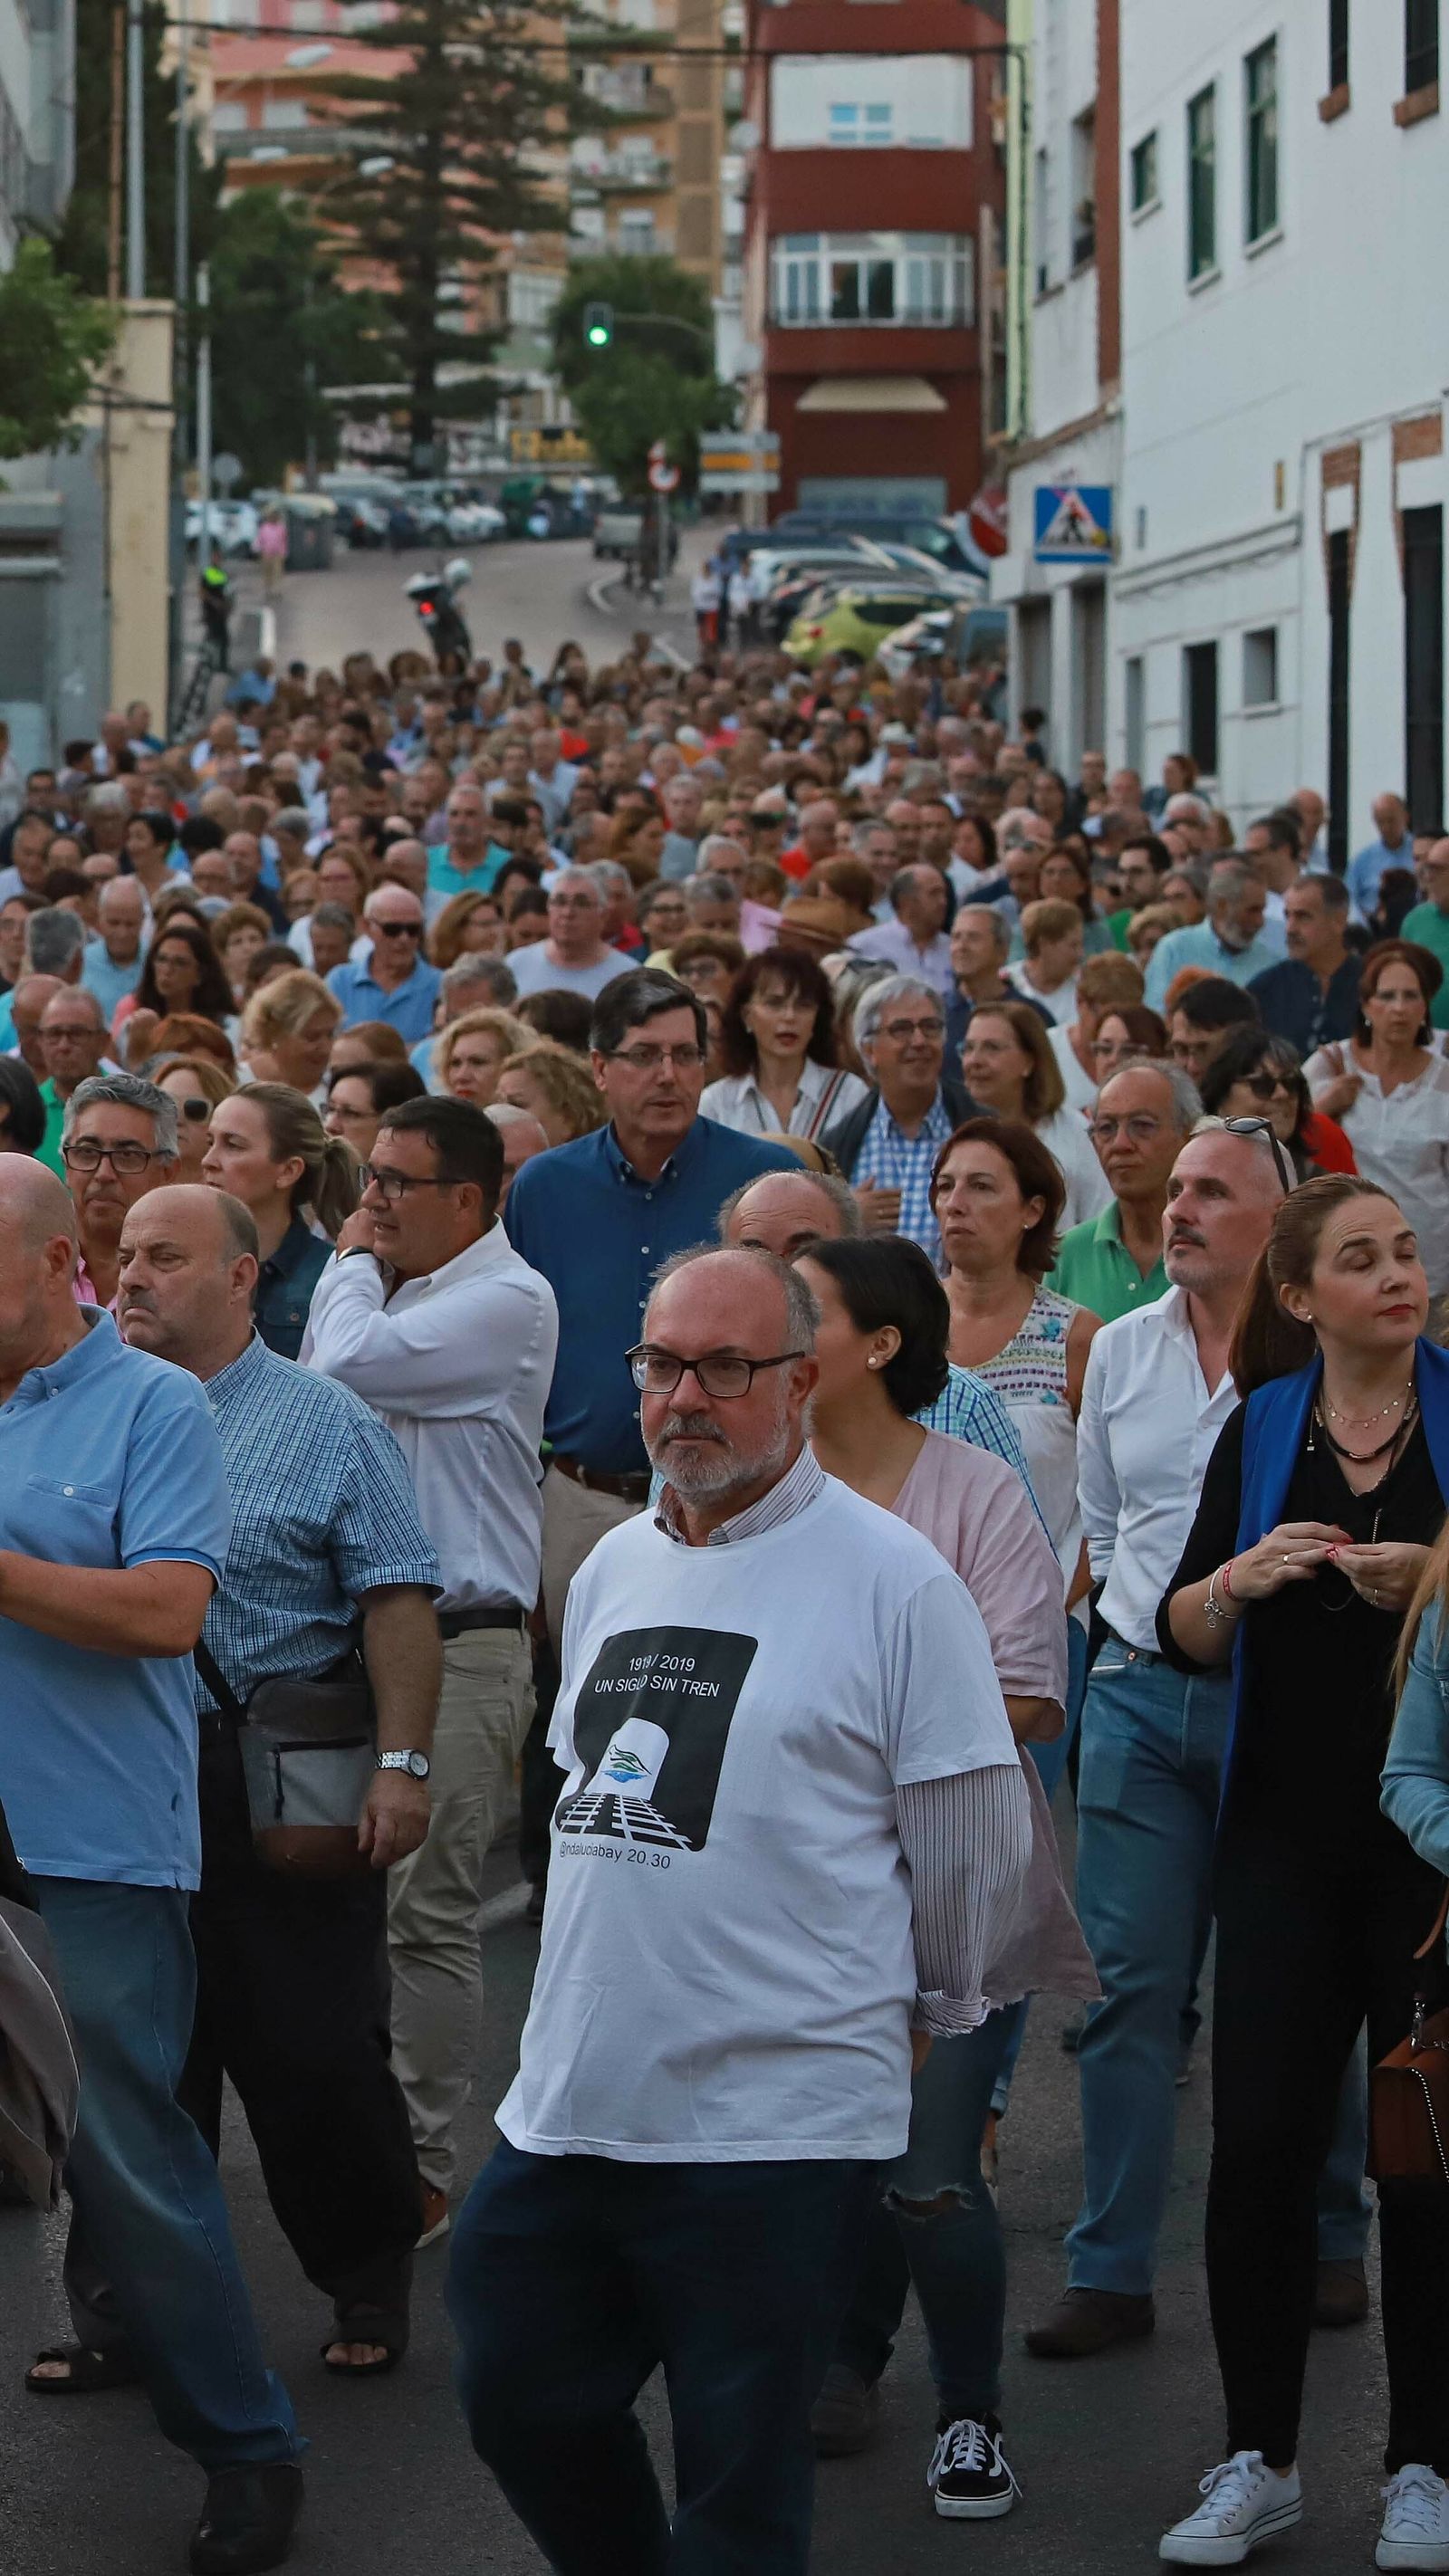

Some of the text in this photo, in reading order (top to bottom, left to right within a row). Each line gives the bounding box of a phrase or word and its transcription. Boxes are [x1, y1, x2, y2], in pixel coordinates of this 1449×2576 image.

[659, 1655, 696, 1671] 2019
[594, 1674, 720, 1697] UN SIGLO SIN TREN
[627, 1849, 670, 1870] 20.30
